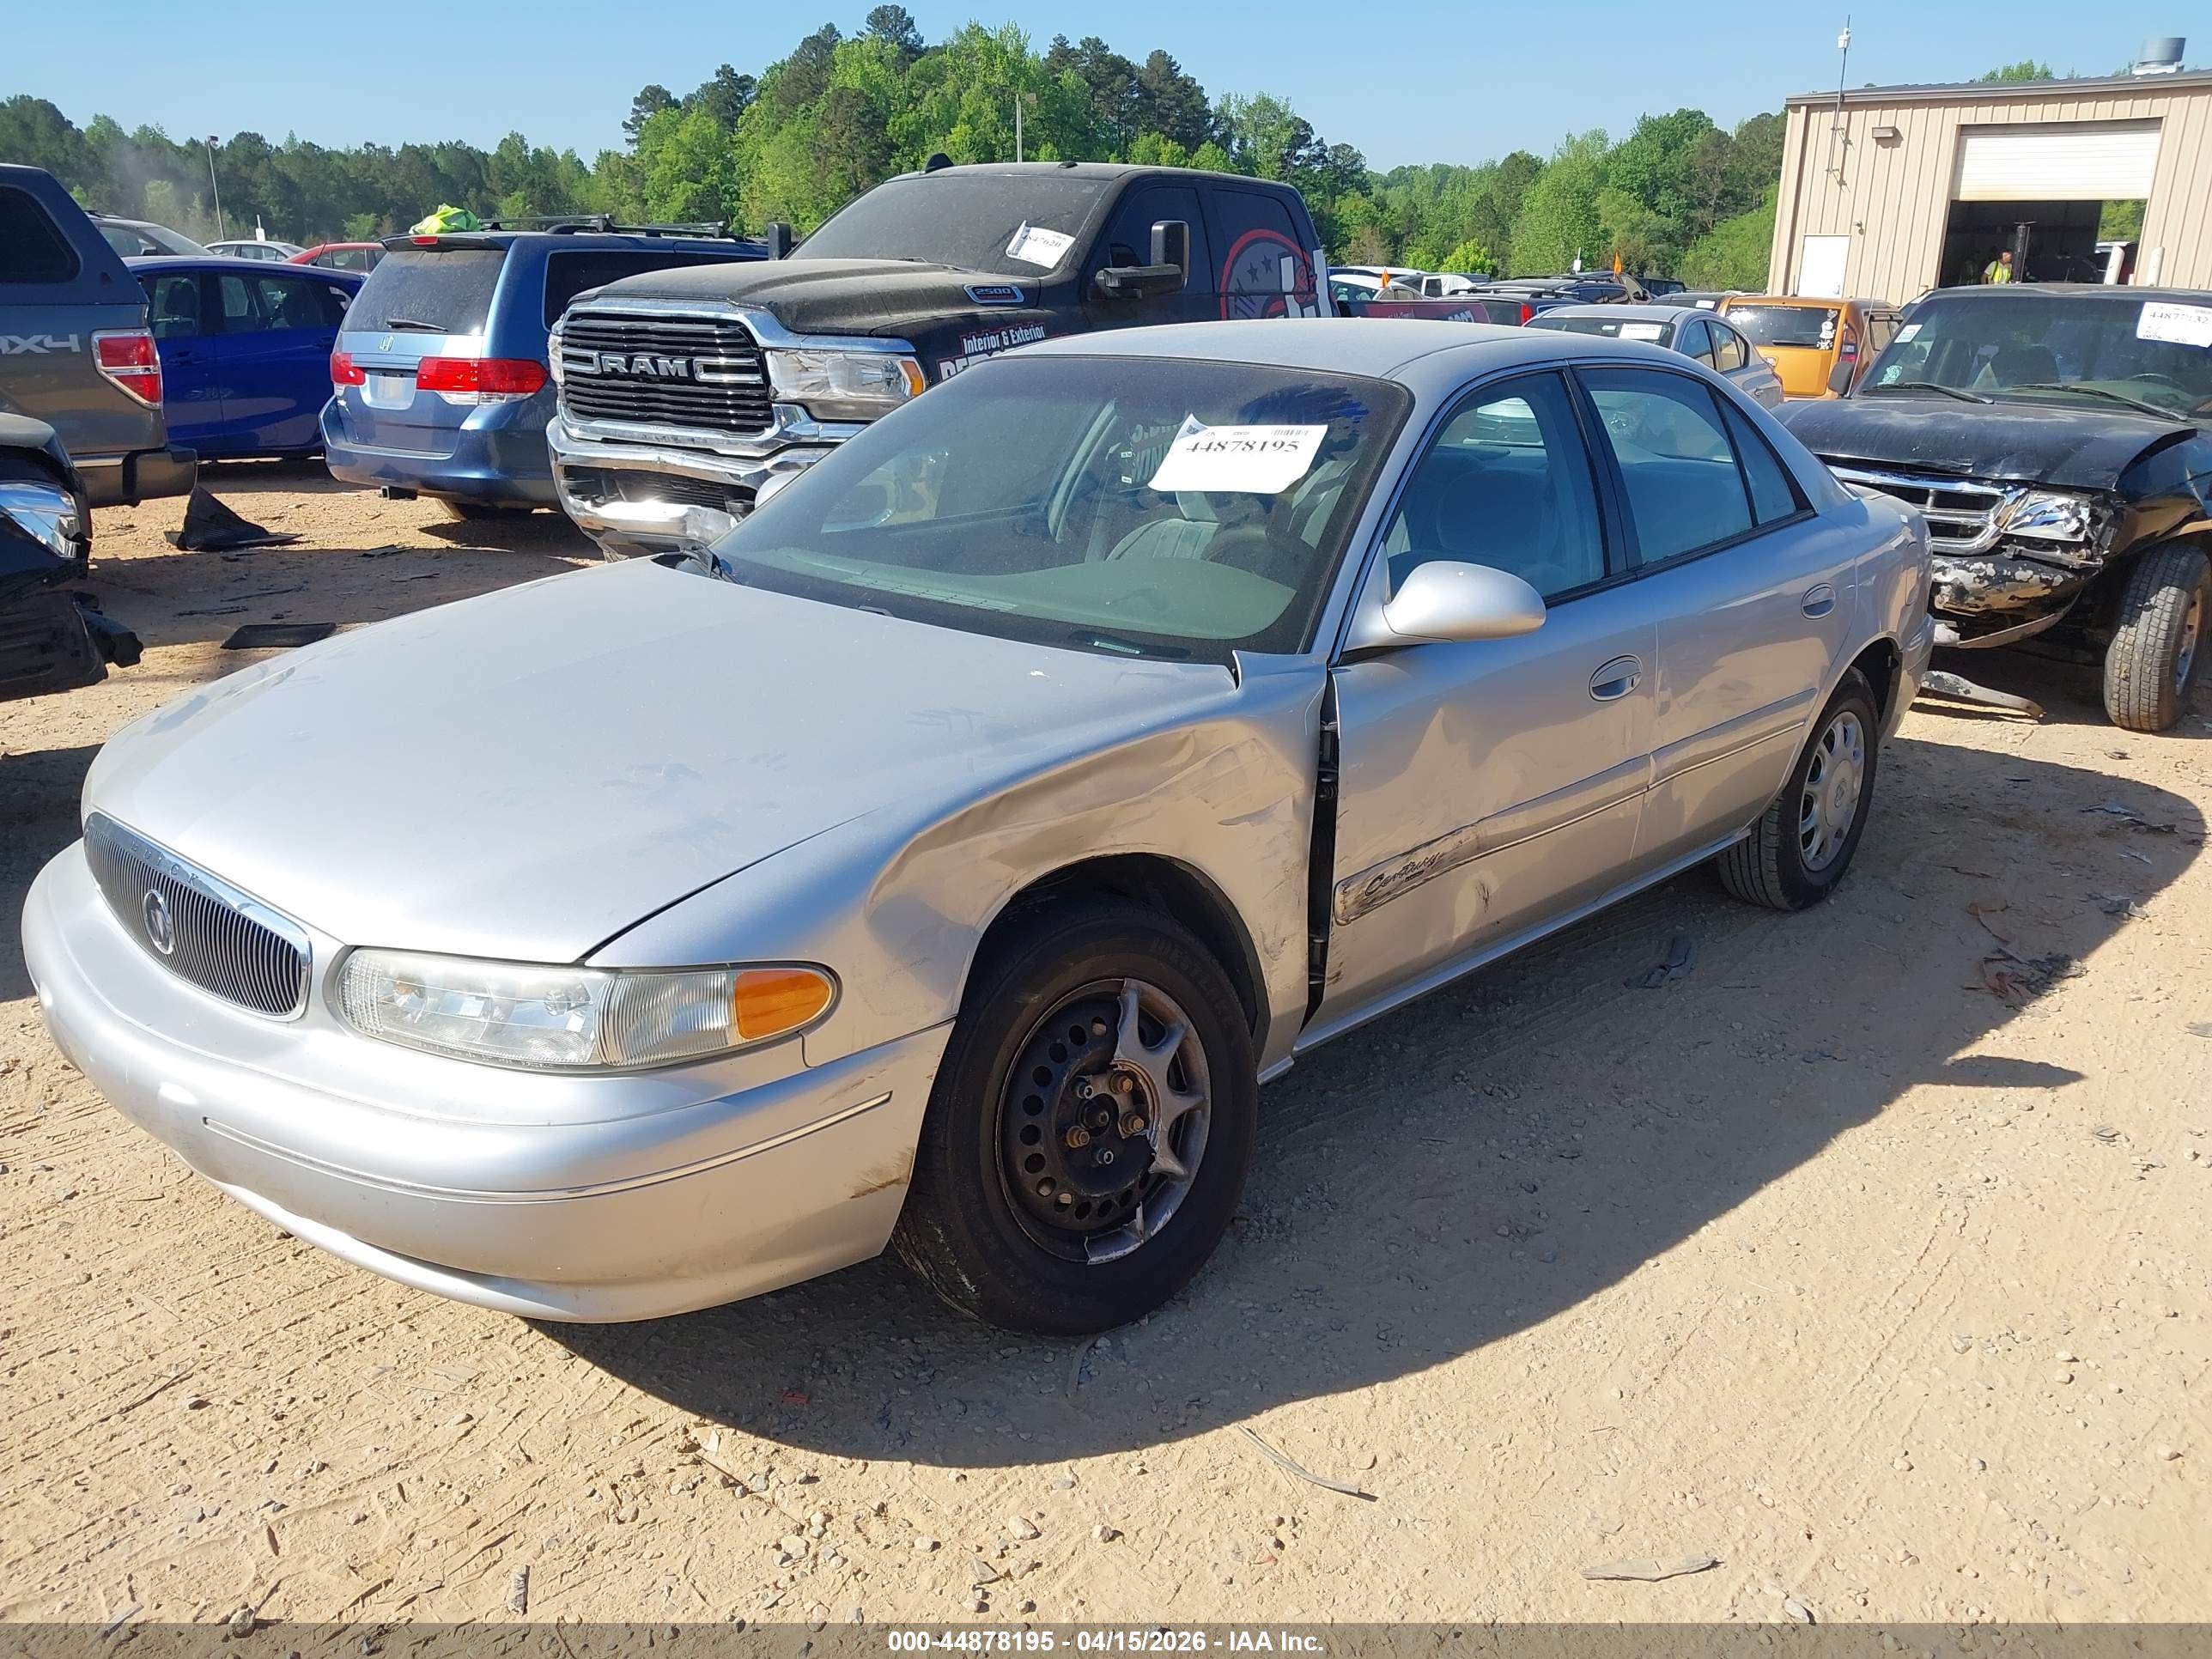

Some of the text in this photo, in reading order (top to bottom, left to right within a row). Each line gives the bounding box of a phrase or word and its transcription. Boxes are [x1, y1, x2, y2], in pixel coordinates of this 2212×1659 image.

[963, 324, 1045, 355] Interior & Exterior
[601, 356, 689, 377] RAM
[1186, 441, 1300, 453] 44878195
[131, 841, 199, 886] BUICK
